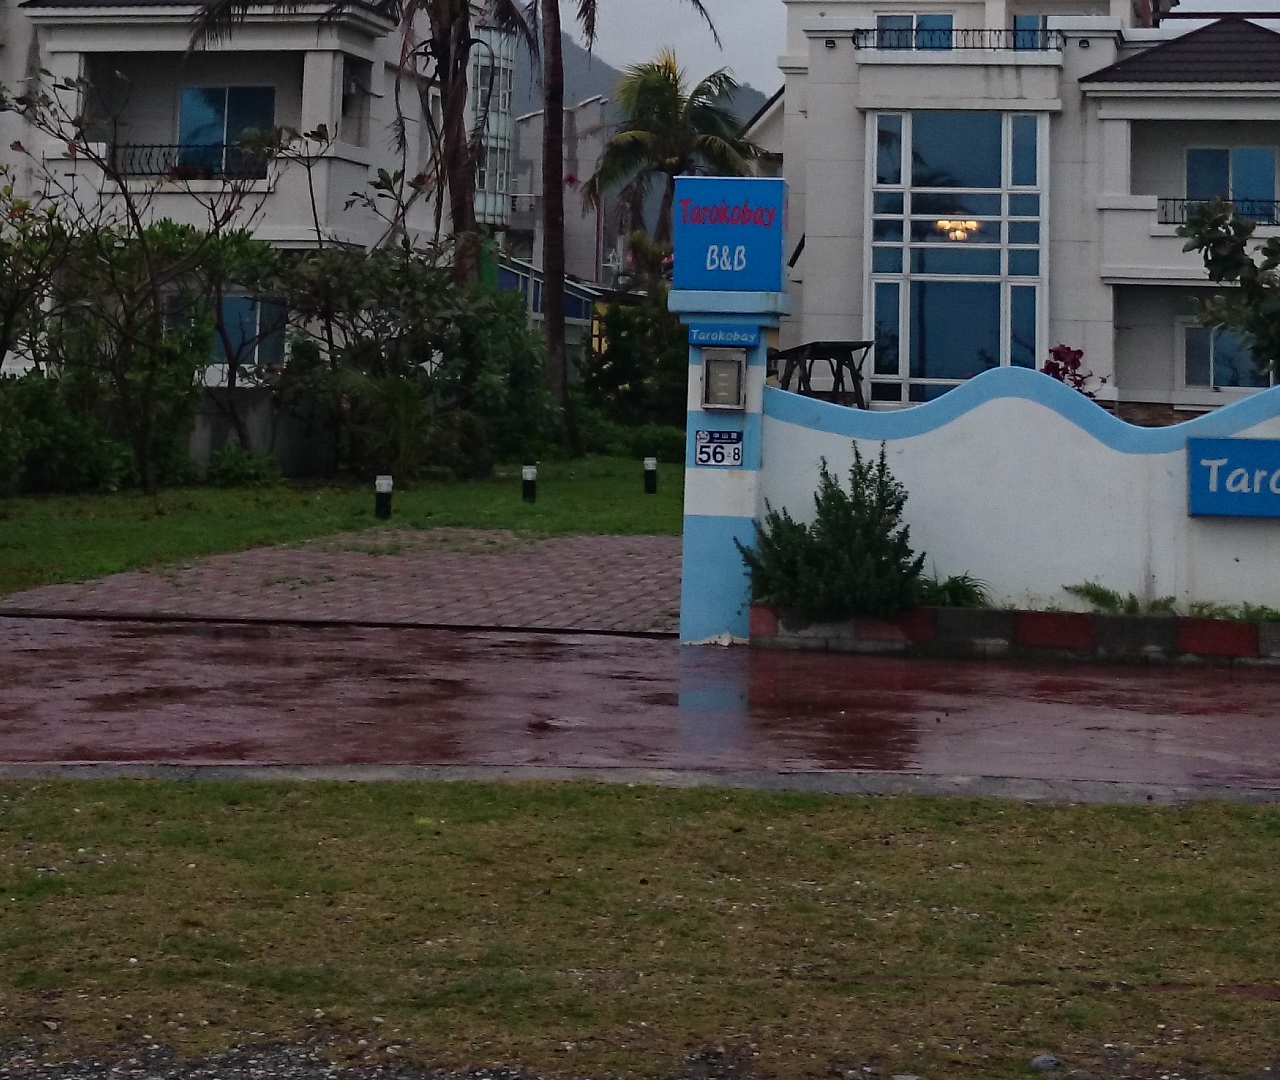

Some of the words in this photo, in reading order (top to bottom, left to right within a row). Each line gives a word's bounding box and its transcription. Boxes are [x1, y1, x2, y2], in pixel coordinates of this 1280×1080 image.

[679, 198, 776, 228] Tarokobay
[706, 244, 746, 271] B&B
[691, 329, 756, 343] Tarokobay
